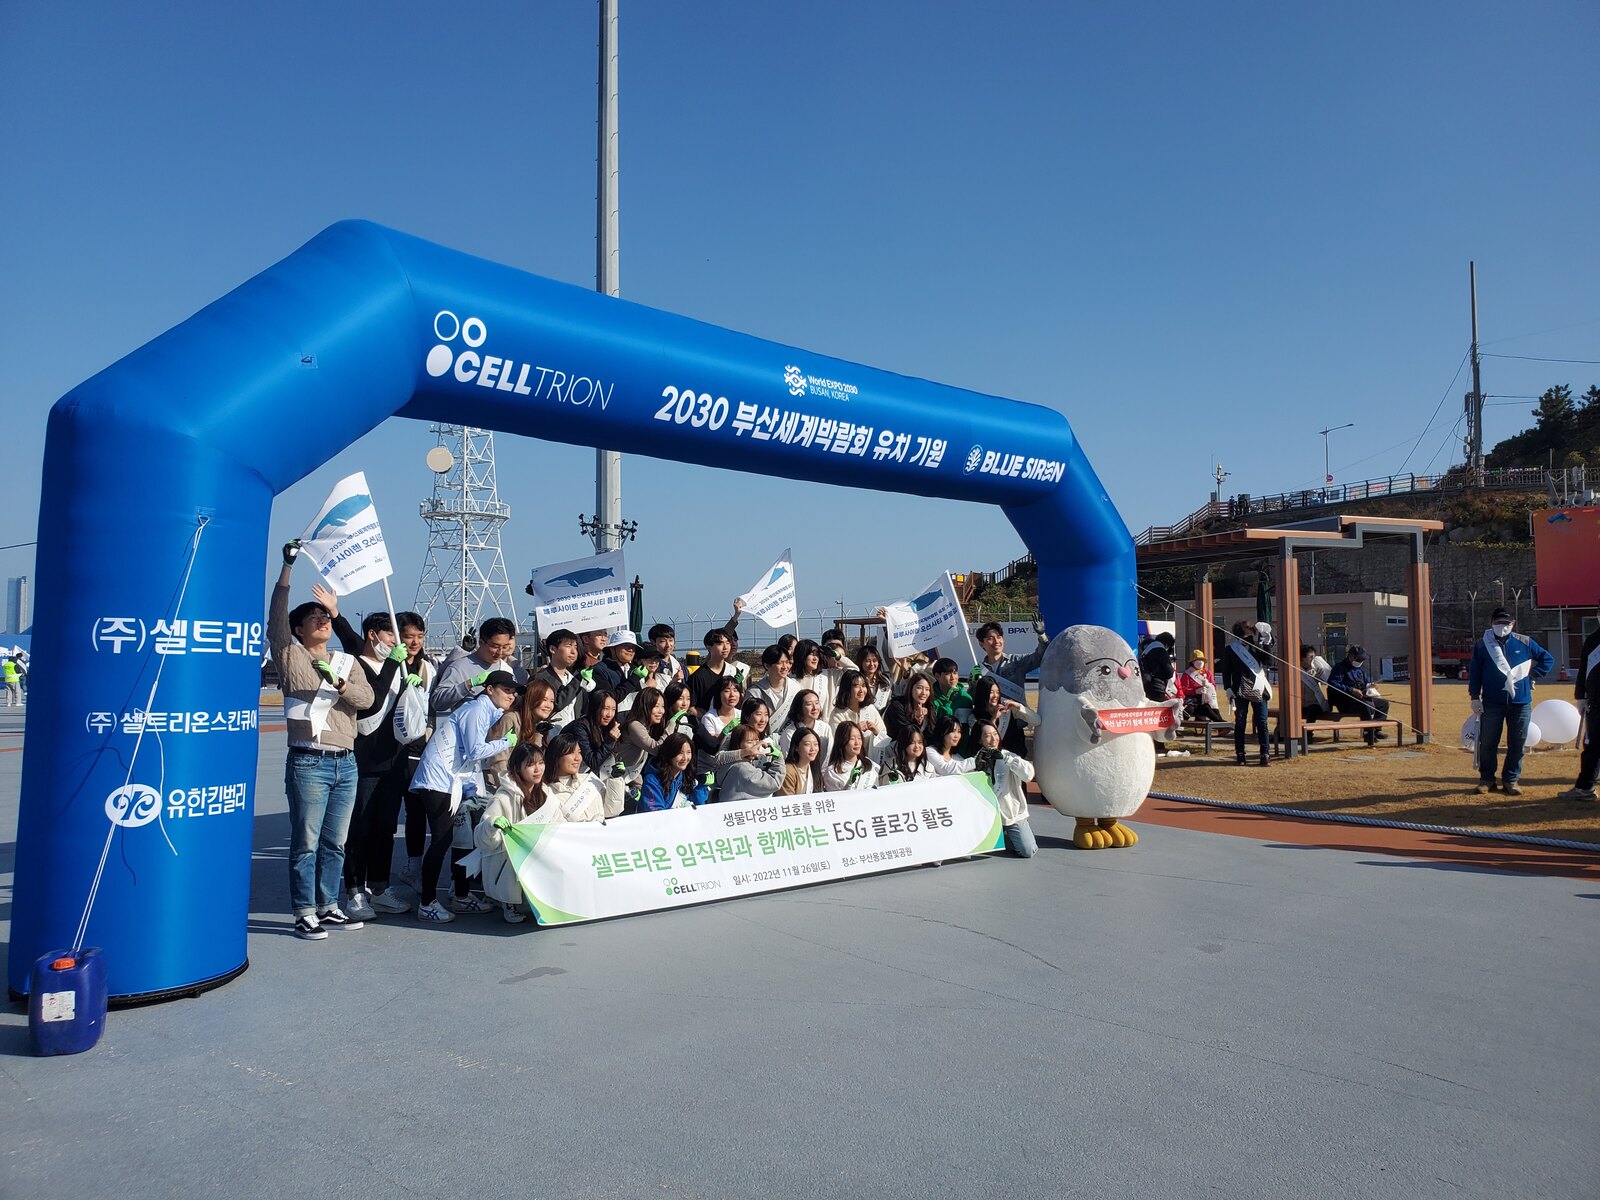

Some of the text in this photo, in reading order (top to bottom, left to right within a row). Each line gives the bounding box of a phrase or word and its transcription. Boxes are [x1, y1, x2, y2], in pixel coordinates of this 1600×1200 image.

[454, 350, 614, 411] CELLTRION
[807, 375, 858, 395] World EXPO 2030
[831, 390, 850, 402] KOREA
[654, 385, 948, 468] 2030 부산세계박람회 유치 기원
[979, 450, 1025, 478] BLUE
[580, 598, 606, 609] 오션시티
[167, 783, 247, 819] 유한킴벌리
[723, 798, 836, 828] 생물다양성 보호를 위한
[591, 806, 954, 878] 셀트리온 임직원과 함께하는 ESG 플로깅 활동
[733, 860, 831, 886] 일시: 2022년 11월 26일(토)
[841, 855, 858, 868] 장소:
[673, 879, 722, 895] CELLTRION
